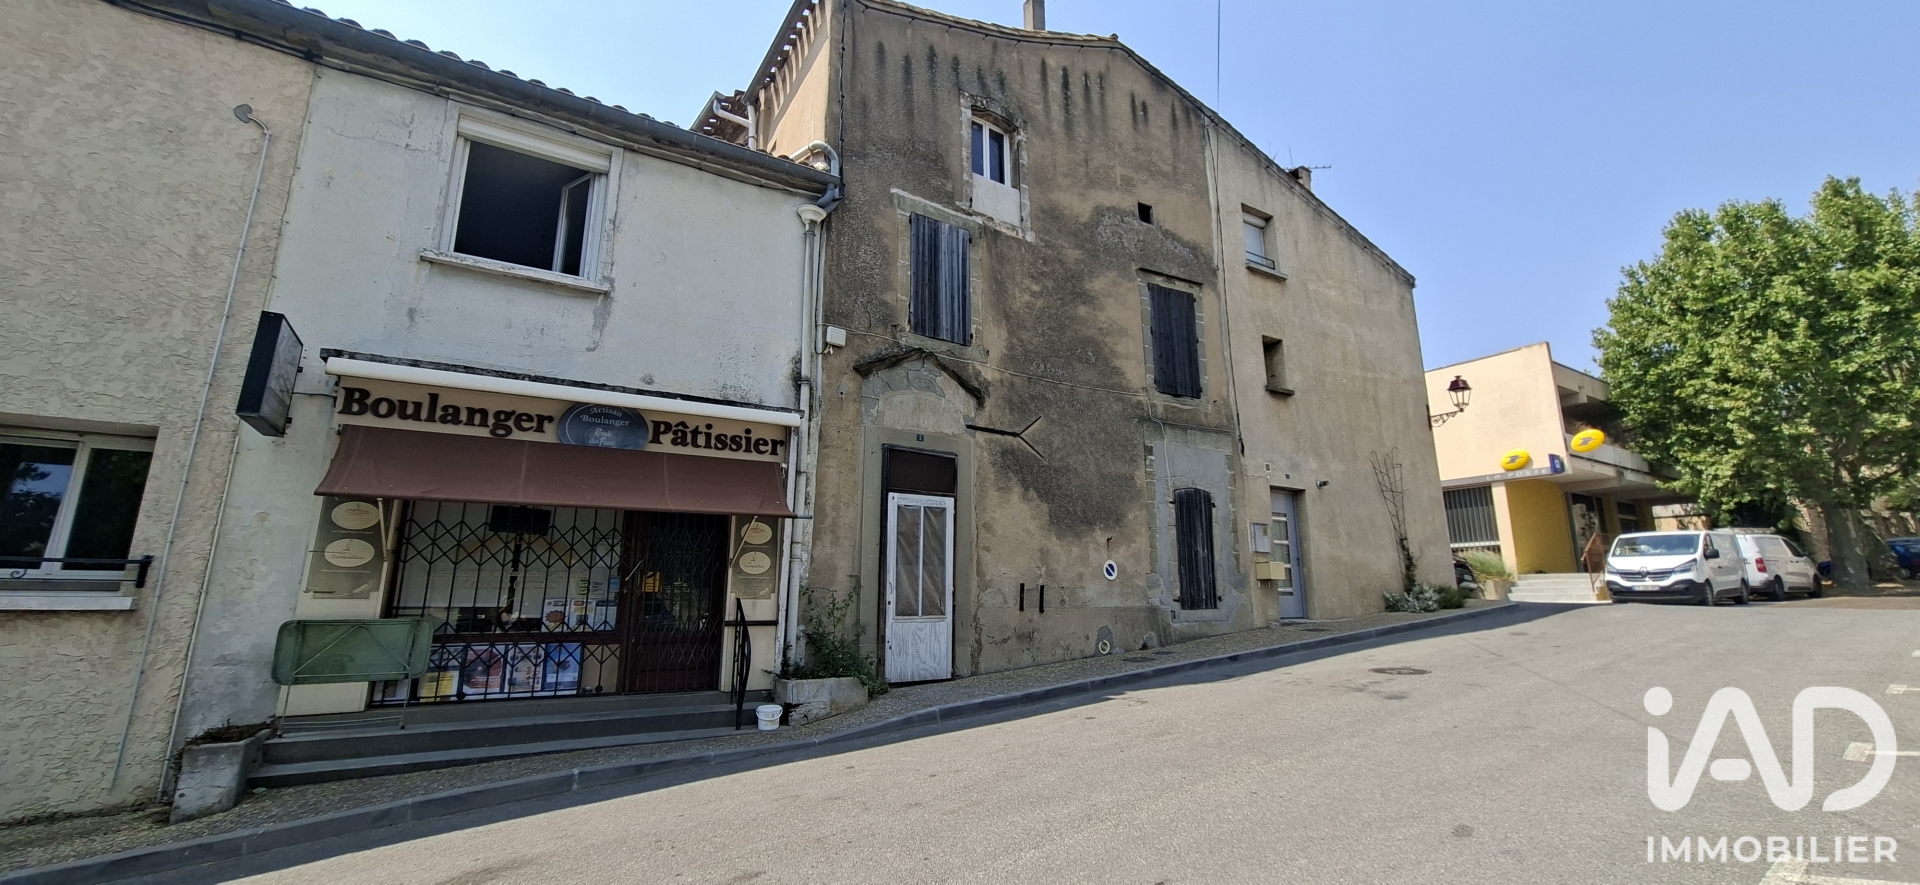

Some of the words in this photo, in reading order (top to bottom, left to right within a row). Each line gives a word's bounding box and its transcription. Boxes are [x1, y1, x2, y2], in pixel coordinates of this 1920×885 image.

[337, 386, 555, 438] Boulanger
[589, 407, 622, 418] Artisan
[580, 414, 630, 427] Boulanger
[649, 420, 786, 456] Pâtissier
[1508, 468, 1548, 478] POSTE
